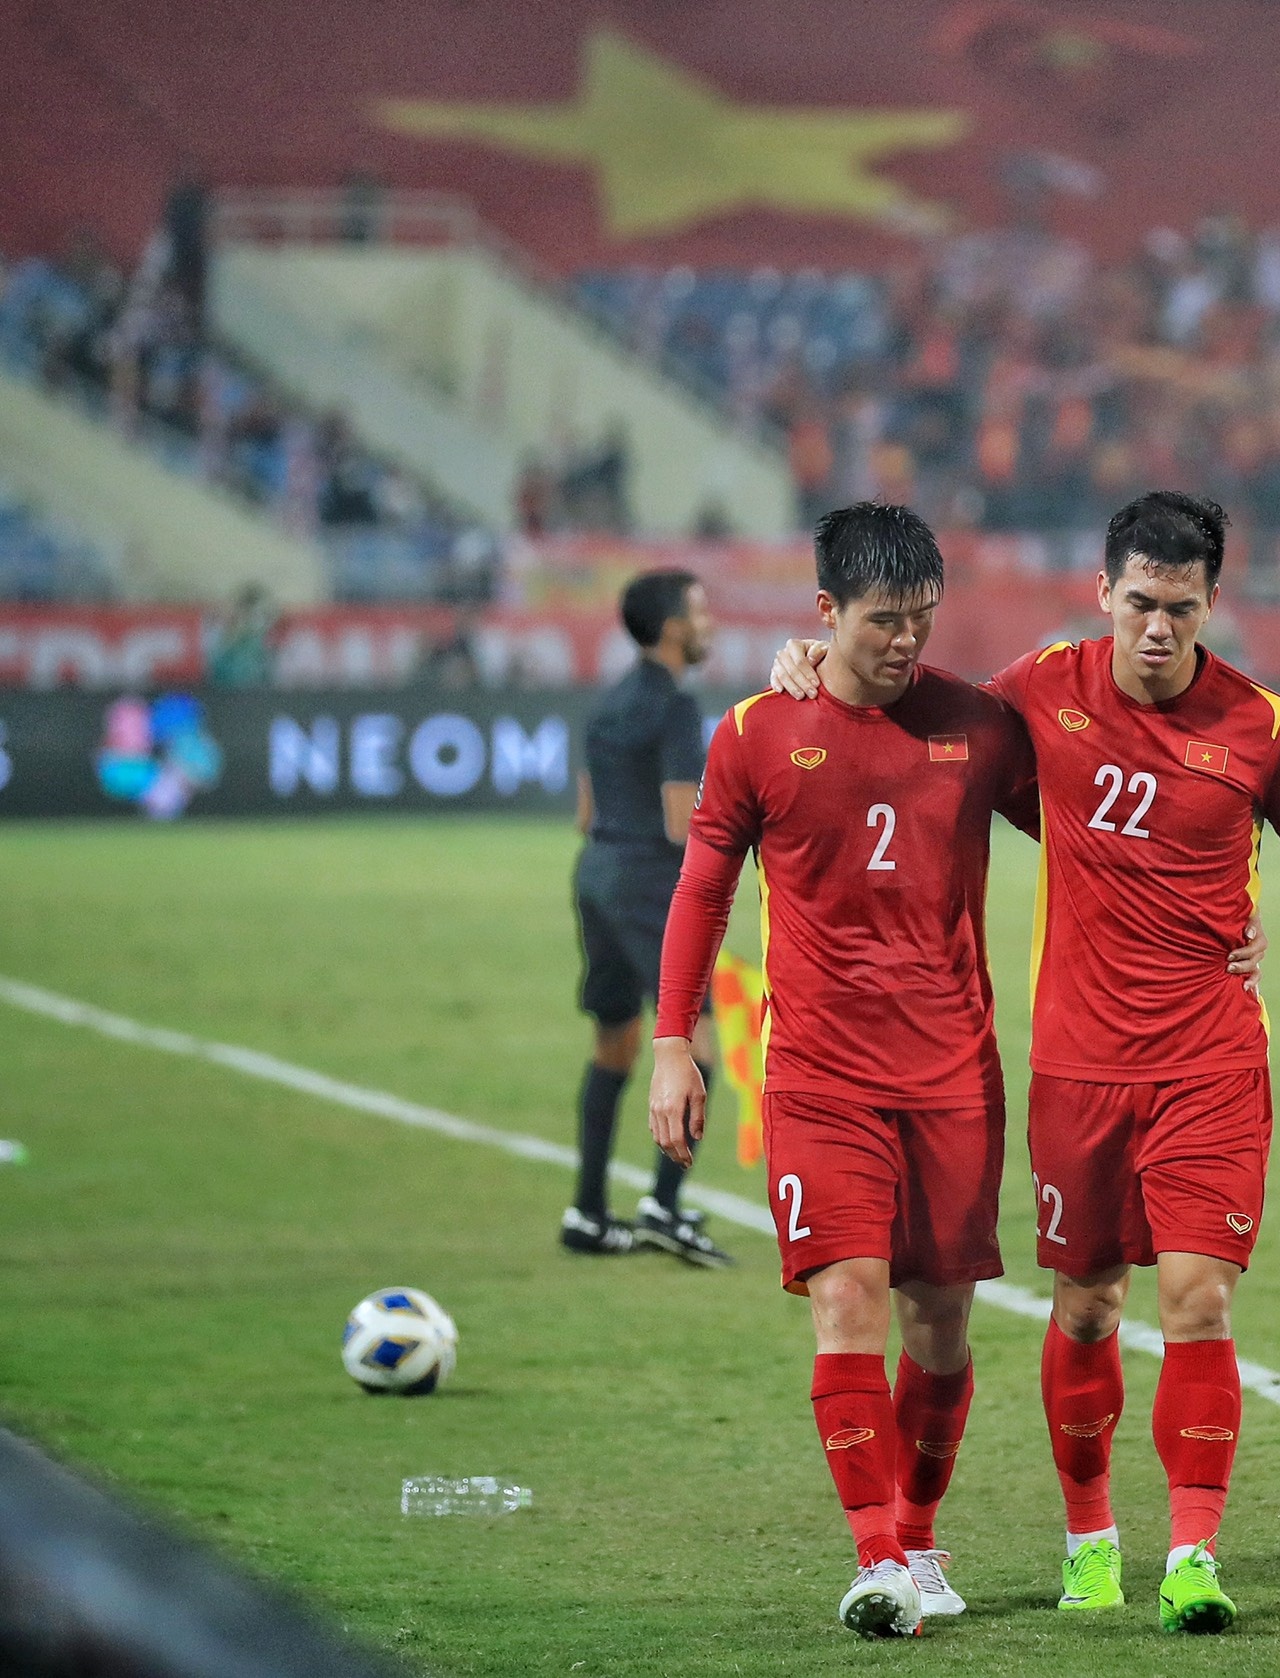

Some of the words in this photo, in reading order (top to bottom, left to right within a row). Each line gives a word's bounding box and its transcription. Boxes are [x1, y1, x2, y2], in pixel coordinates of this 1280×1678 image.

[268, 713, 569, 796] NEOM
[866, 803, 896, 870] 2
[1087, 764, 1158, 839] 22
[778, 1173, 811, 1242] 2
